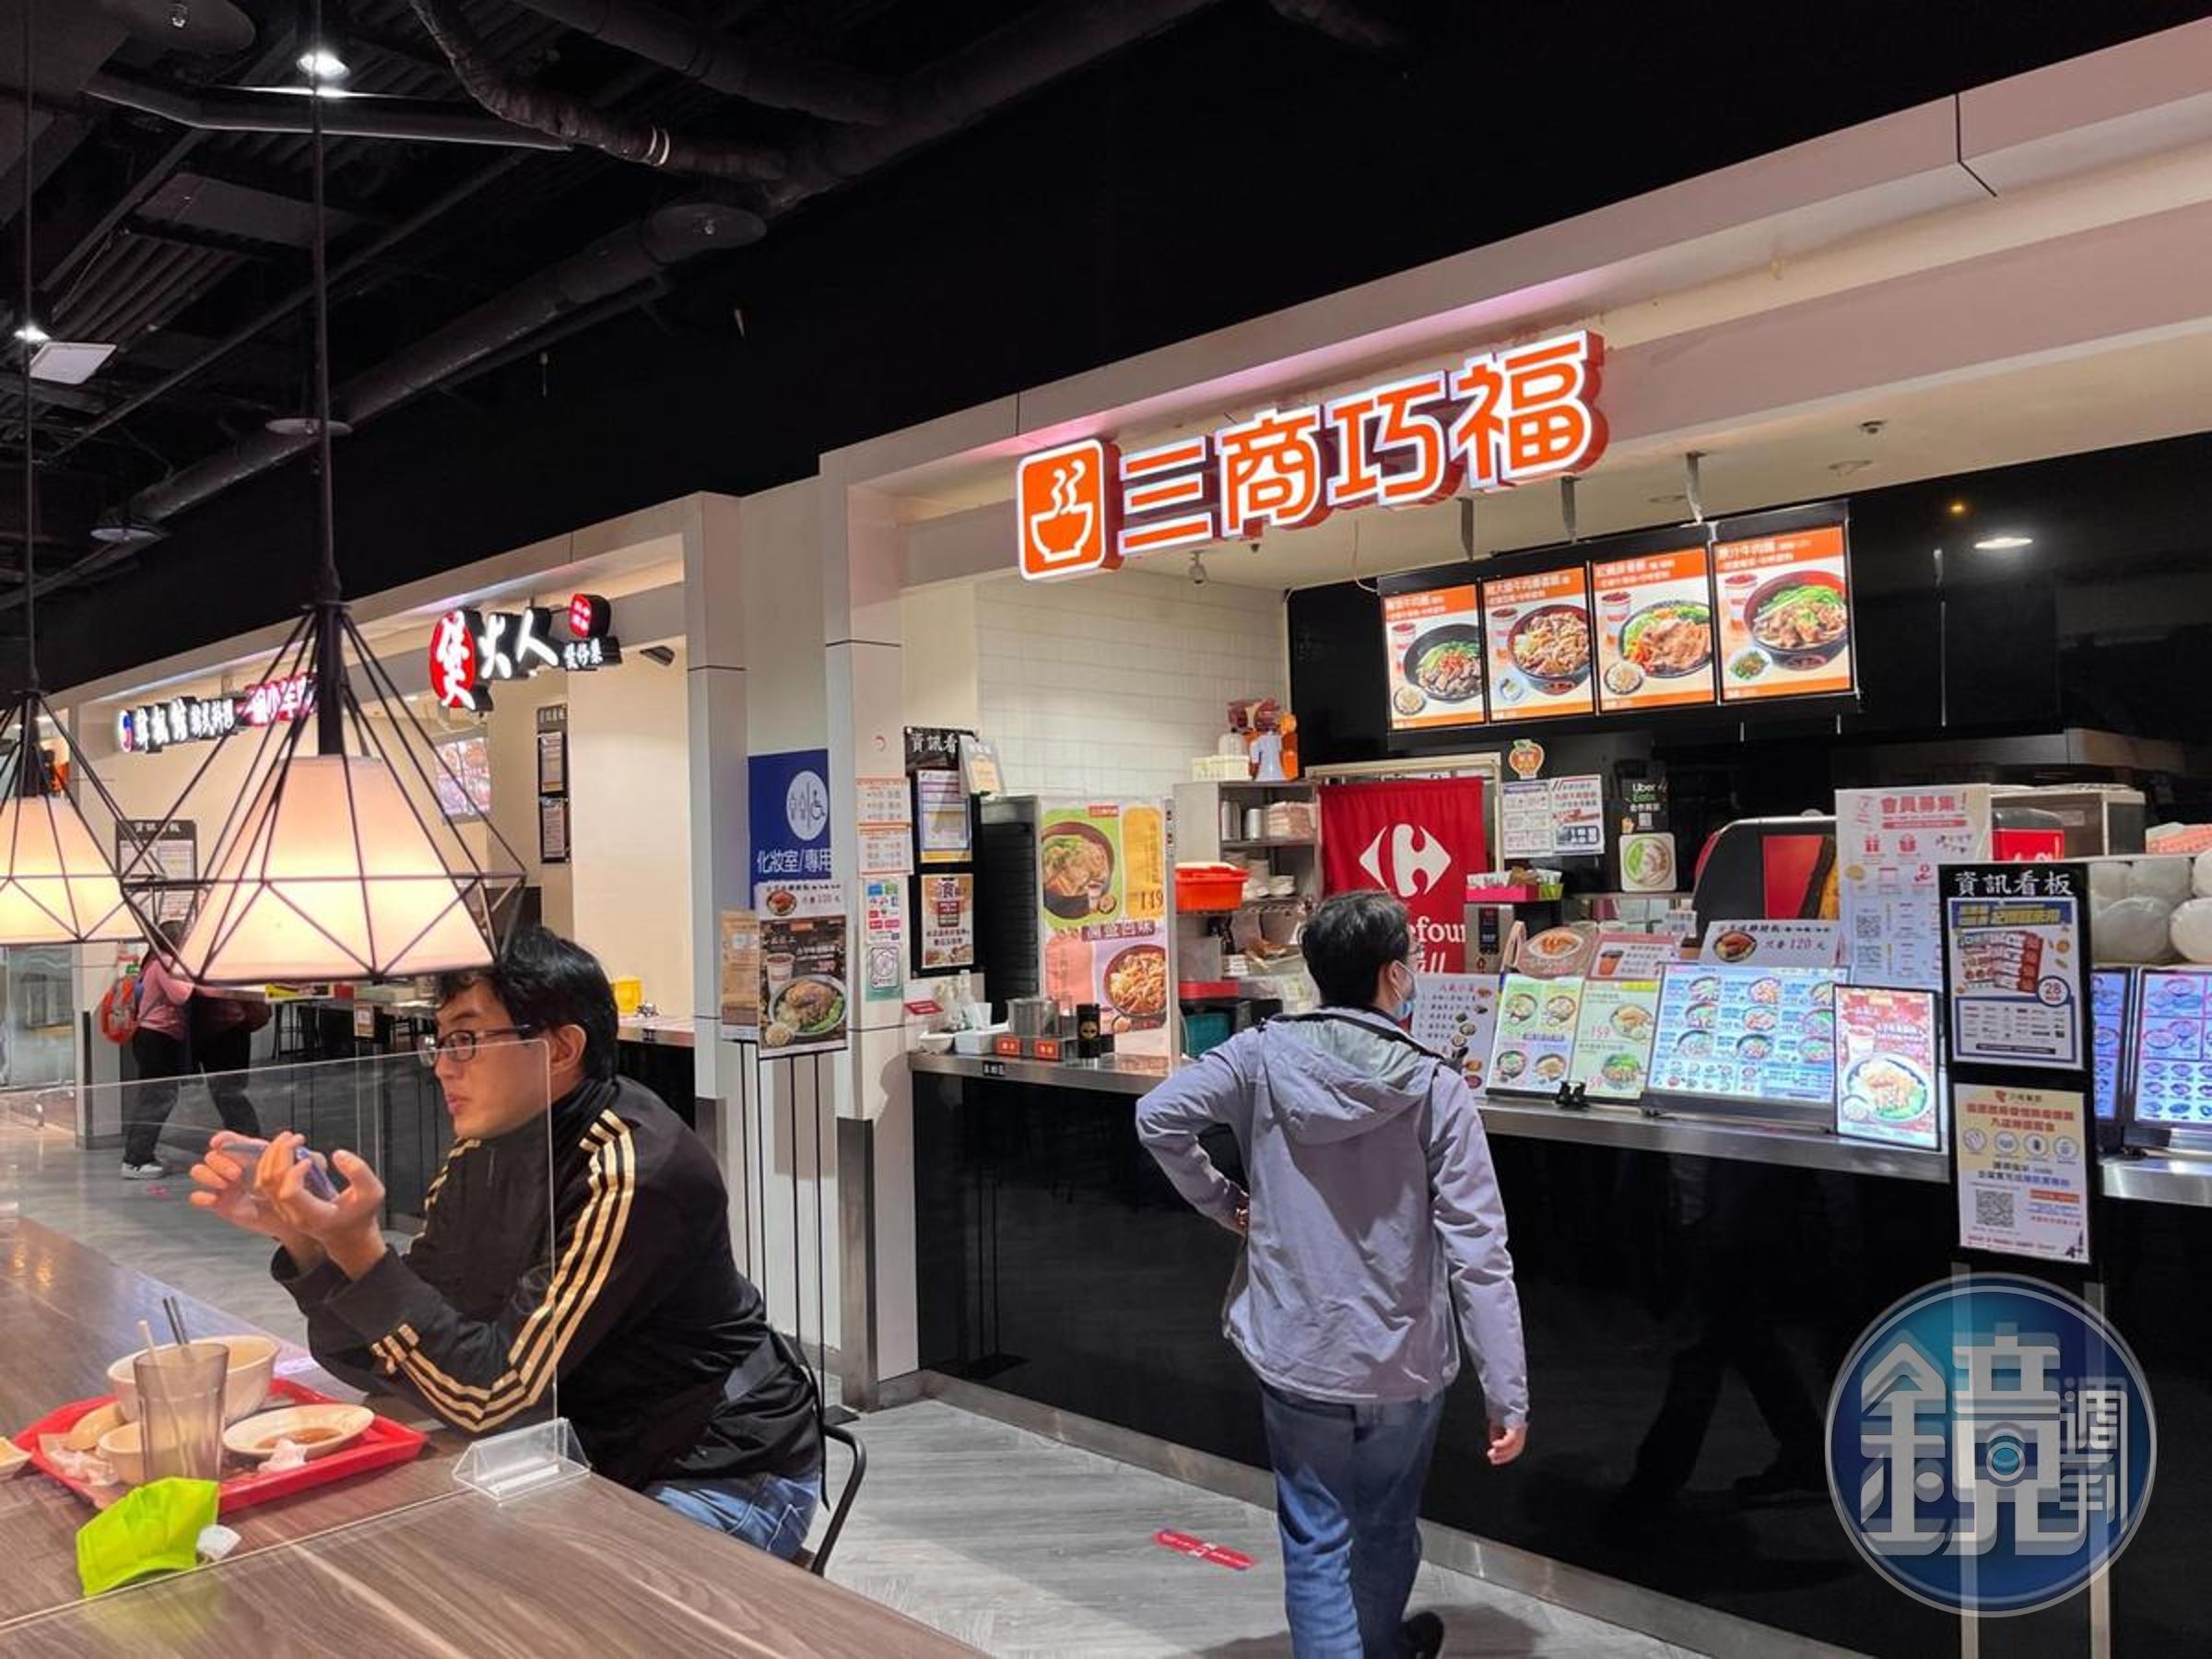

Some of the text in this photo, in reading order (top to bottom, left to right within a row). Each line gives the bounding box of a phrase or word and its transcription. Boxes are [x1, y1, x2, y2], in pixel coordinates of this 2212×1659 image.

[1118, 329, 1596, 557] 三商巧福
[911, 734, 960, 754] 資訊看
[1955, 869, 2076, 897] 資訊看板
